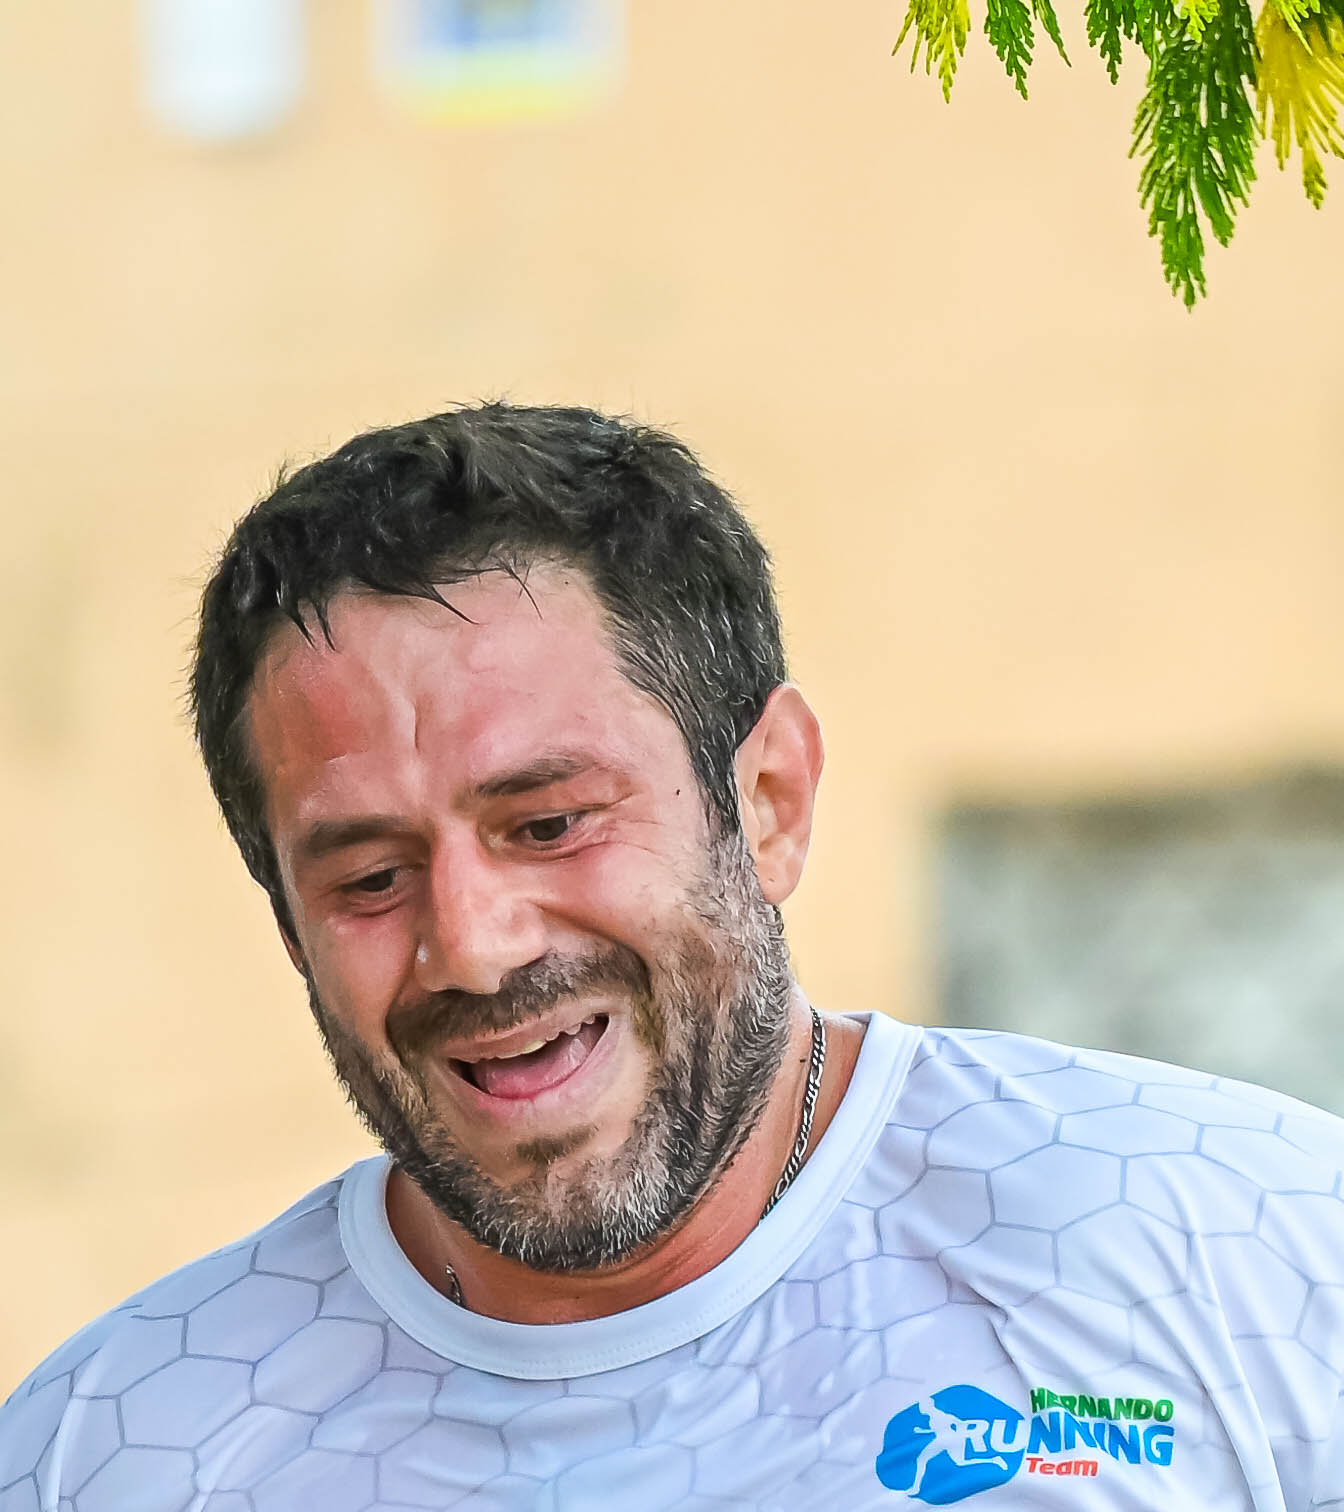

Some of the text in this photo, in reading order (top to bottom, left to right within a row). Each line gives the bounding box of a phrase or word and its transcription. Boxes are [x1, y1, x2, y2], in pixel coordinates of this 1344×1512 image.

[1030, 1387, 1174, 1422] HERNANDO
[952, 1411, 1175, 1466] RUNNING
[1026, 1457, 1099, 1477] Team
